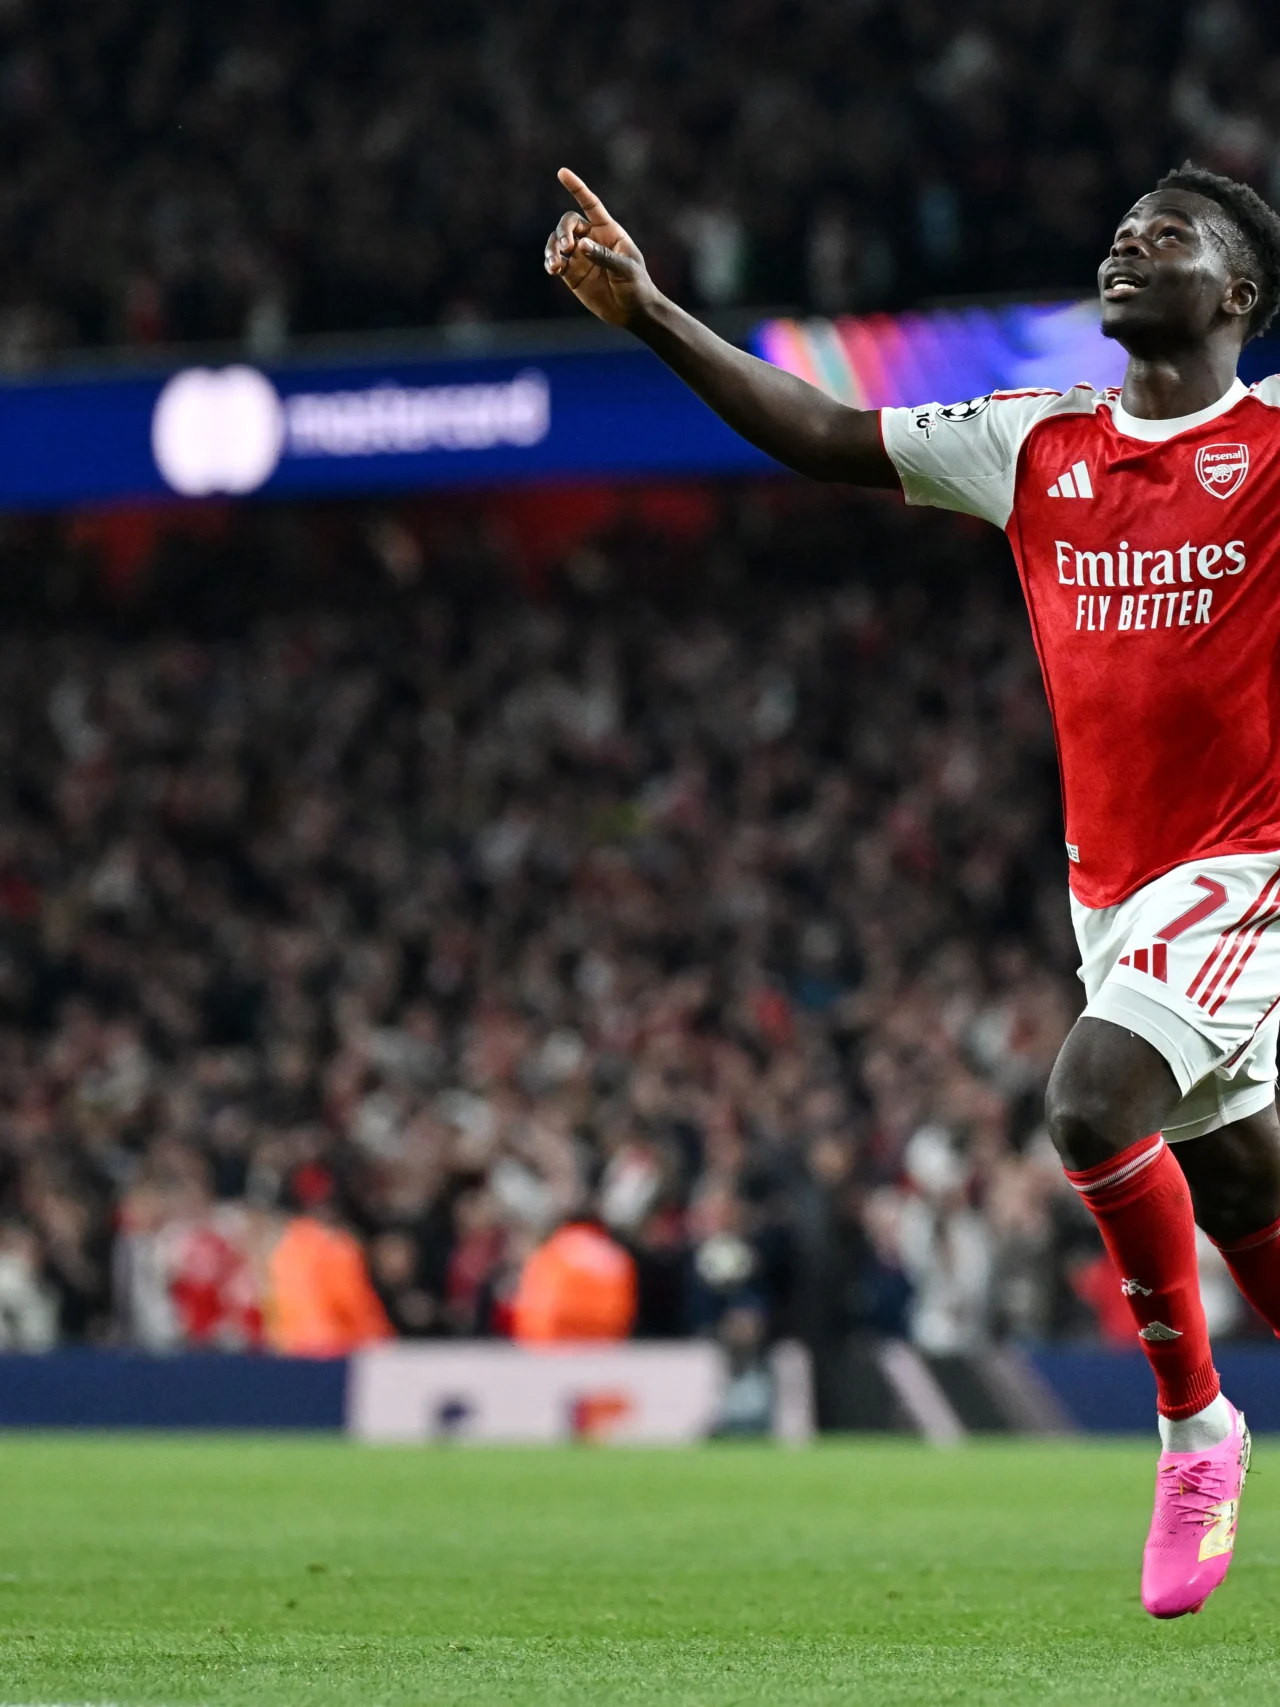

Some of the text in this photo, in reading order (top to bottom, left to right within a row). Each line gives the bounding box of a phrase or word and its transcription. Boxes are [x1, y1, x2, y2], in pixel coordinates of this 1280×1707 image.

[1203, 450, 1242, 462] Arsenal
[1054, 540, 1247, 587] Emirates
[1075, 588, 1214, 632] FLY BETTER
[1152, 874, 1230, 944] 7
